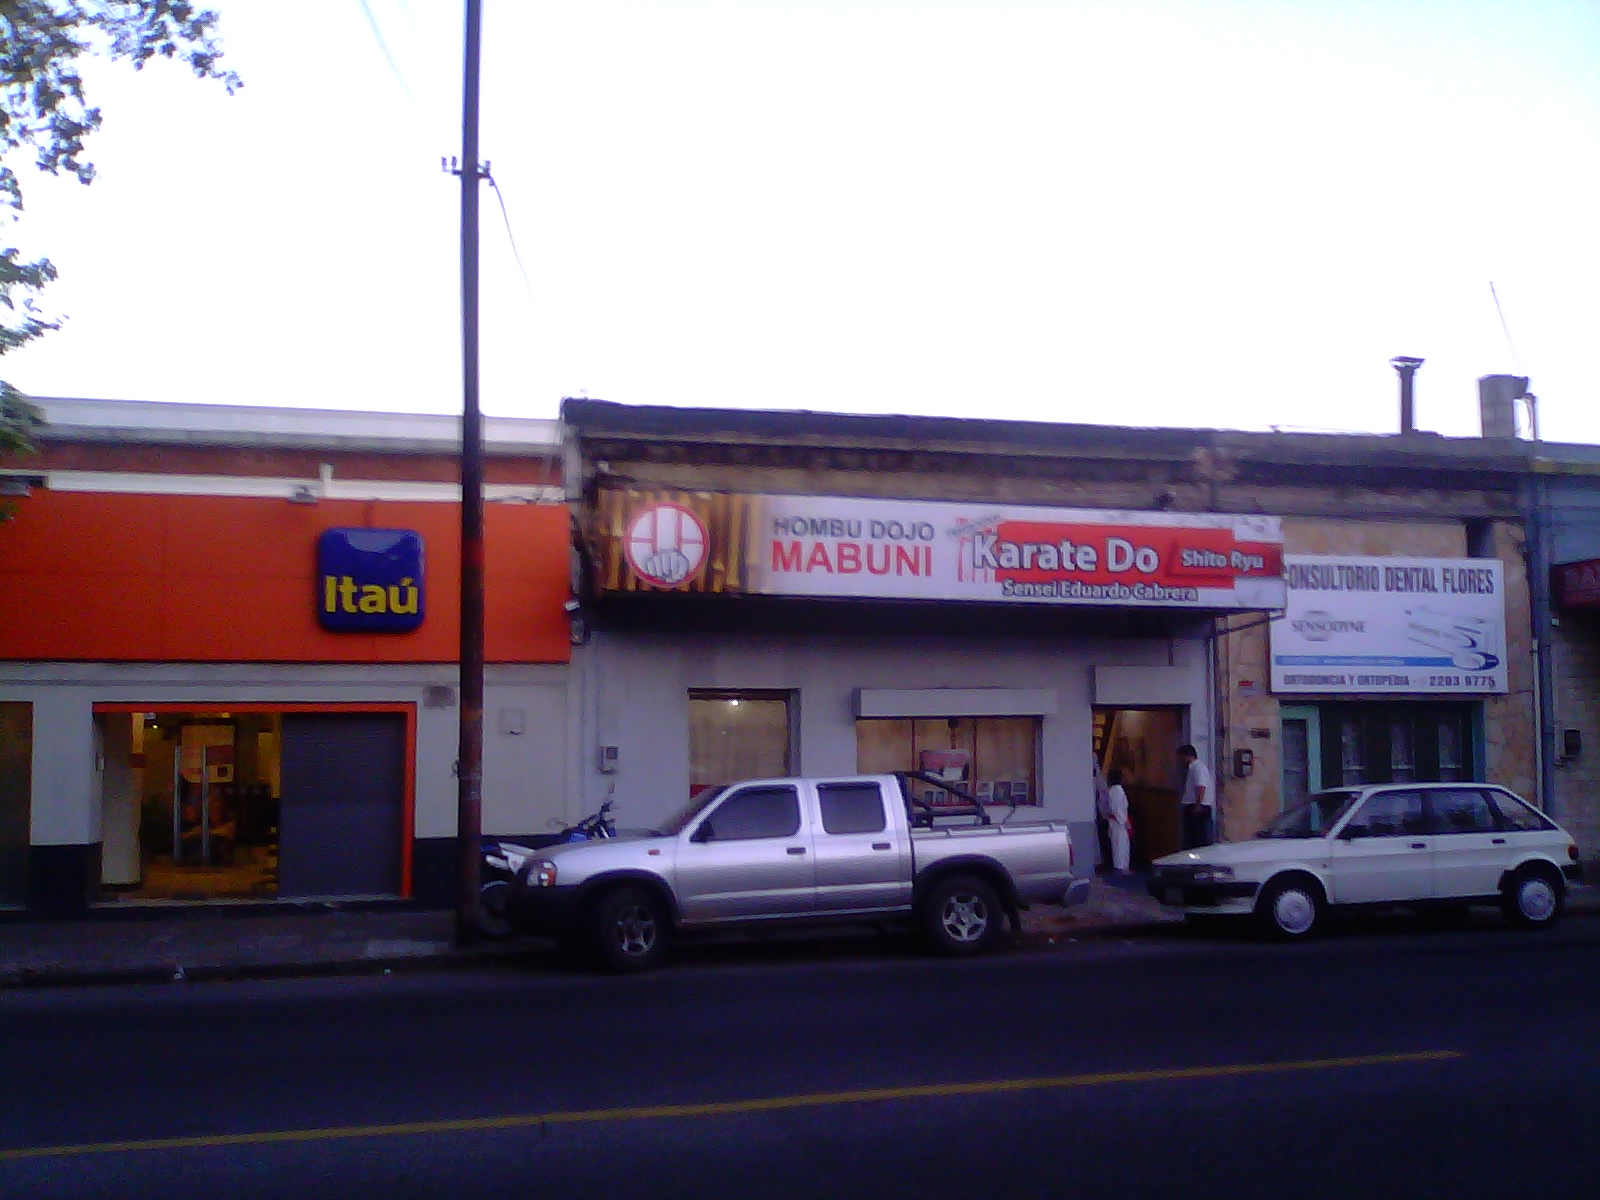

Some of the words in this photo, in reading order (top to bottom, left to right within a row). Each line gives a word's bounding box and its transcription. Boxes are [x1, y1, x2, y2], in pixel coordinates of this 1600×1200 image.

[773, 516, 863, 540] HOMBU
[870, 520, 936, 542] DOJO
[771, 540, 935, 578] MABUNI
[972, 533, 1099, 572] Karate
[1106, 537, 1160, 573] Do
[1181, 548, 1228, 569] Shito
[1229, 549, 1265, 573] Ryu
[1002, 578, 1058, 597] Sensei
[1060, 580, 1130, 600] Eduardo
[1132, 583, 1199, 602] Cabrera
[1384, 566, 1438, 593] DENTAL
[1442, 568, 1495, 595] FLORES
[324, 575, 419, 616] Itaú
[1348, 674, 1355, 686] Y
[1357, 674, 1410, 687] ORTOPEDIA
[1429, 675, 1461, 688] 2203
